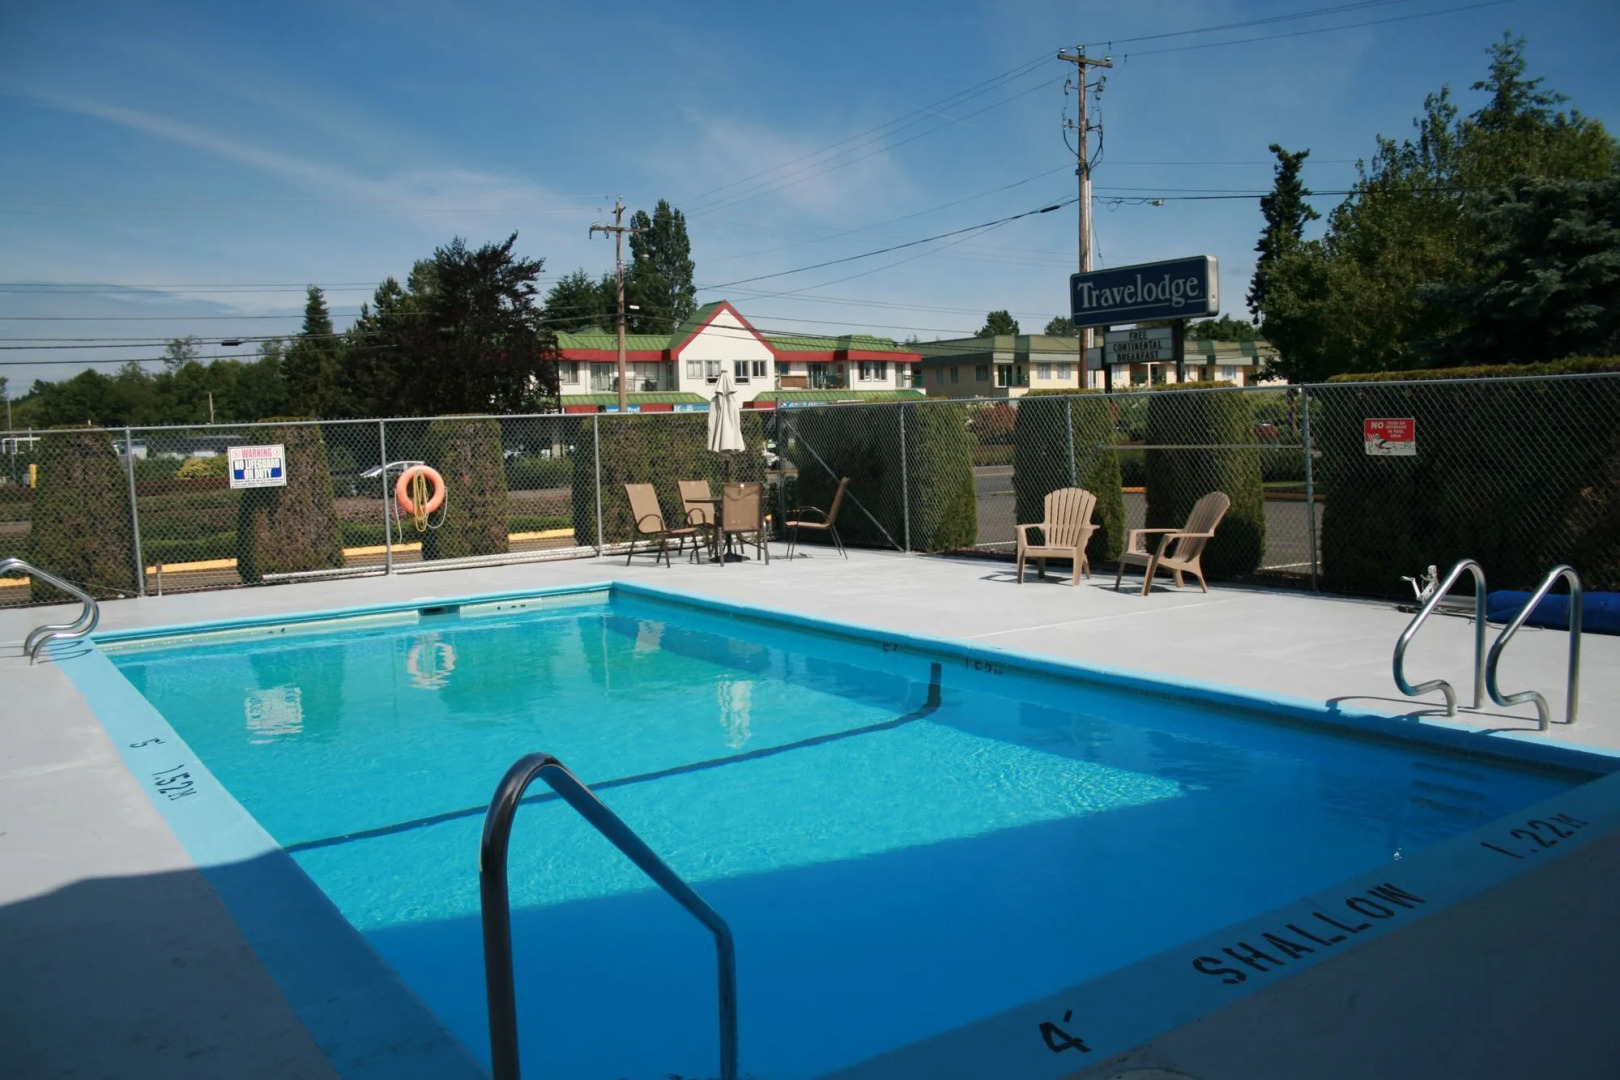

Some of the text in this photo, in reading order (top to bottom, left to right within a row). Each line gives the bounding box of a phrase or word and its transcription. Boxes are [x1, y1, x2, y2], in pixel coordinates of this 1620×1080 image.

[1077, 273, 1199, 308] Travelodge
[1129, 330, 1148, 341] FREE
[1113, 339, 1162, 353] CONTINENTAL
[1116, 350, 1160, 362] BREAKFAST
[1370, 421, 1385, 430] NO
[241, 447, 273, 459] WARNING
[233, 457, 281, 471] NO LIFEGUARD
[243, 467, 272, 480] ON DUTY
[129, 737, 167, 749] 5'
[151, 763, 198, 802] 1.52M
[1038, 812, 1590, 1054] 4' SHALLOW 1.22M
